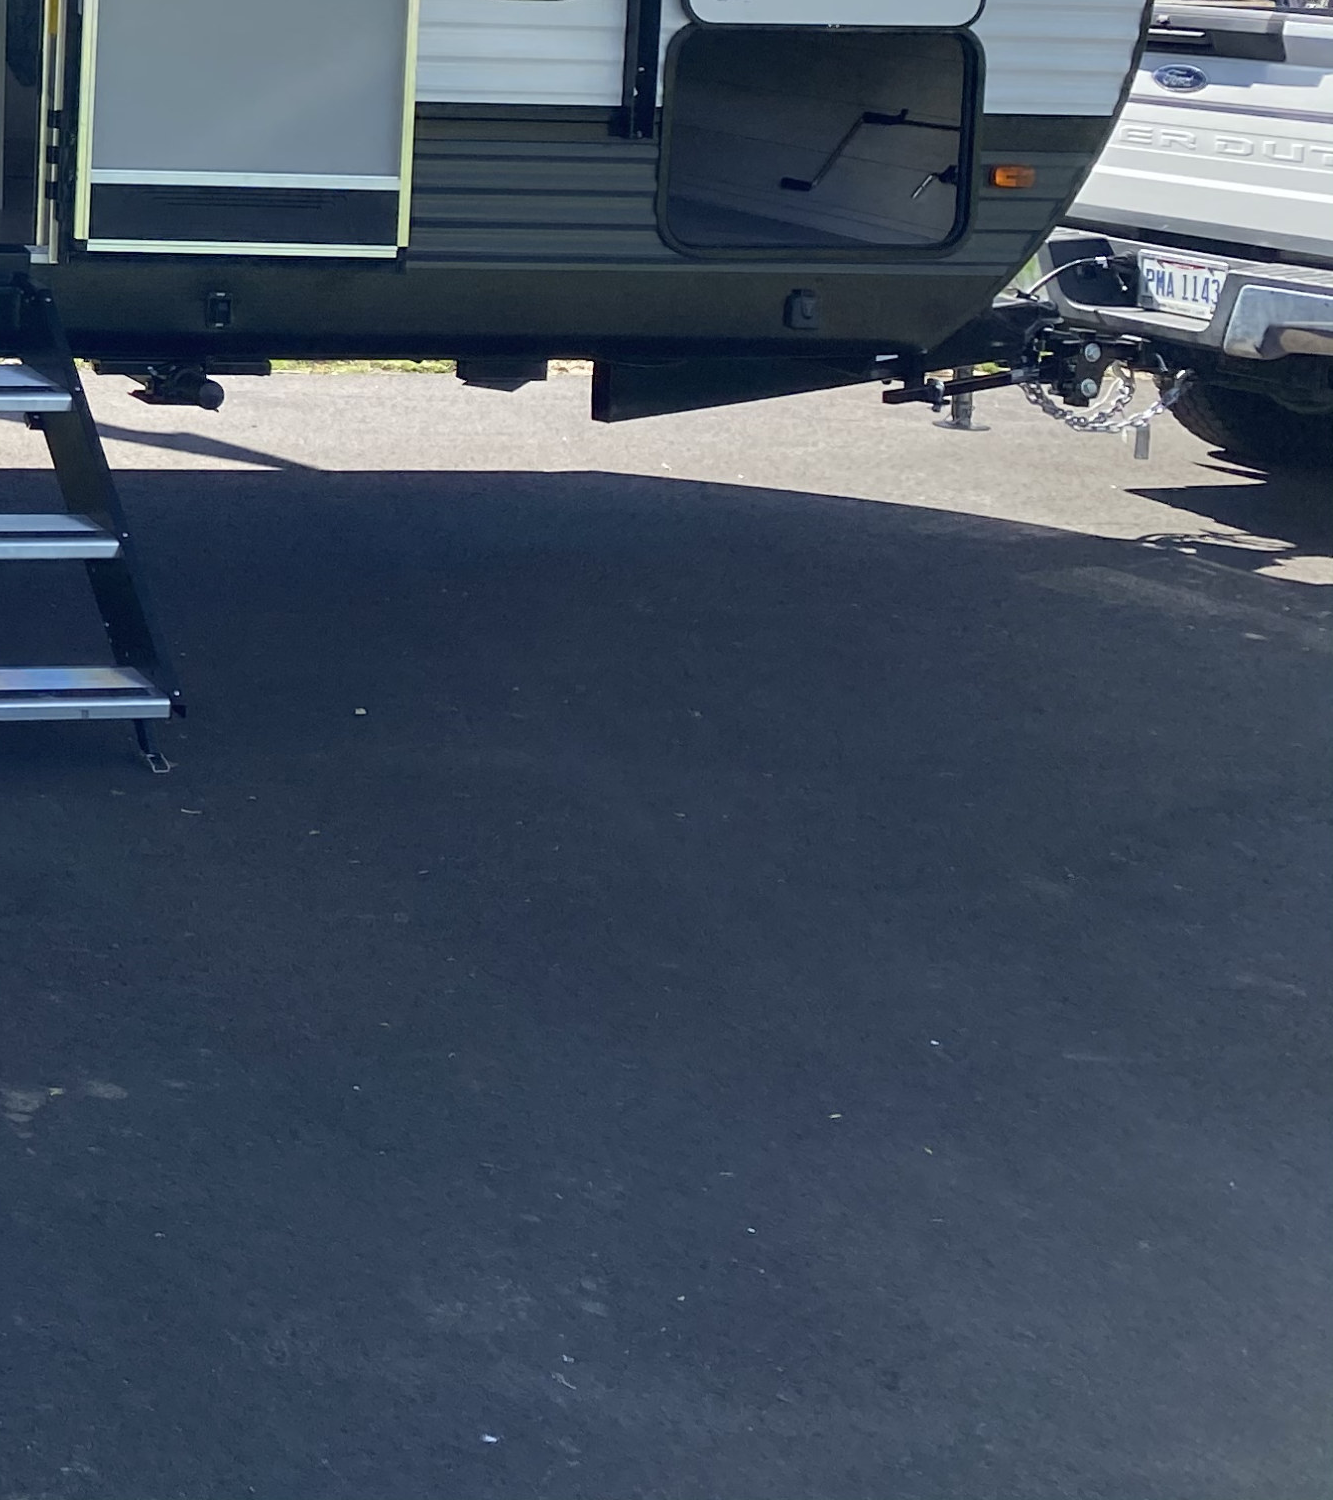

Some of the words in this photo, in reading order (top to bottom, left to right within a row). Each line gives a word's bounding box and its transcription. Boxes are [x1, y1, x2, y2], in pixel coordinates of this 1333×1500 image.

[1118, 124, 1197, 151] ER
[1214, 134, 1333, 169] DUT
[1181, 273, 1222, 306] 1143
